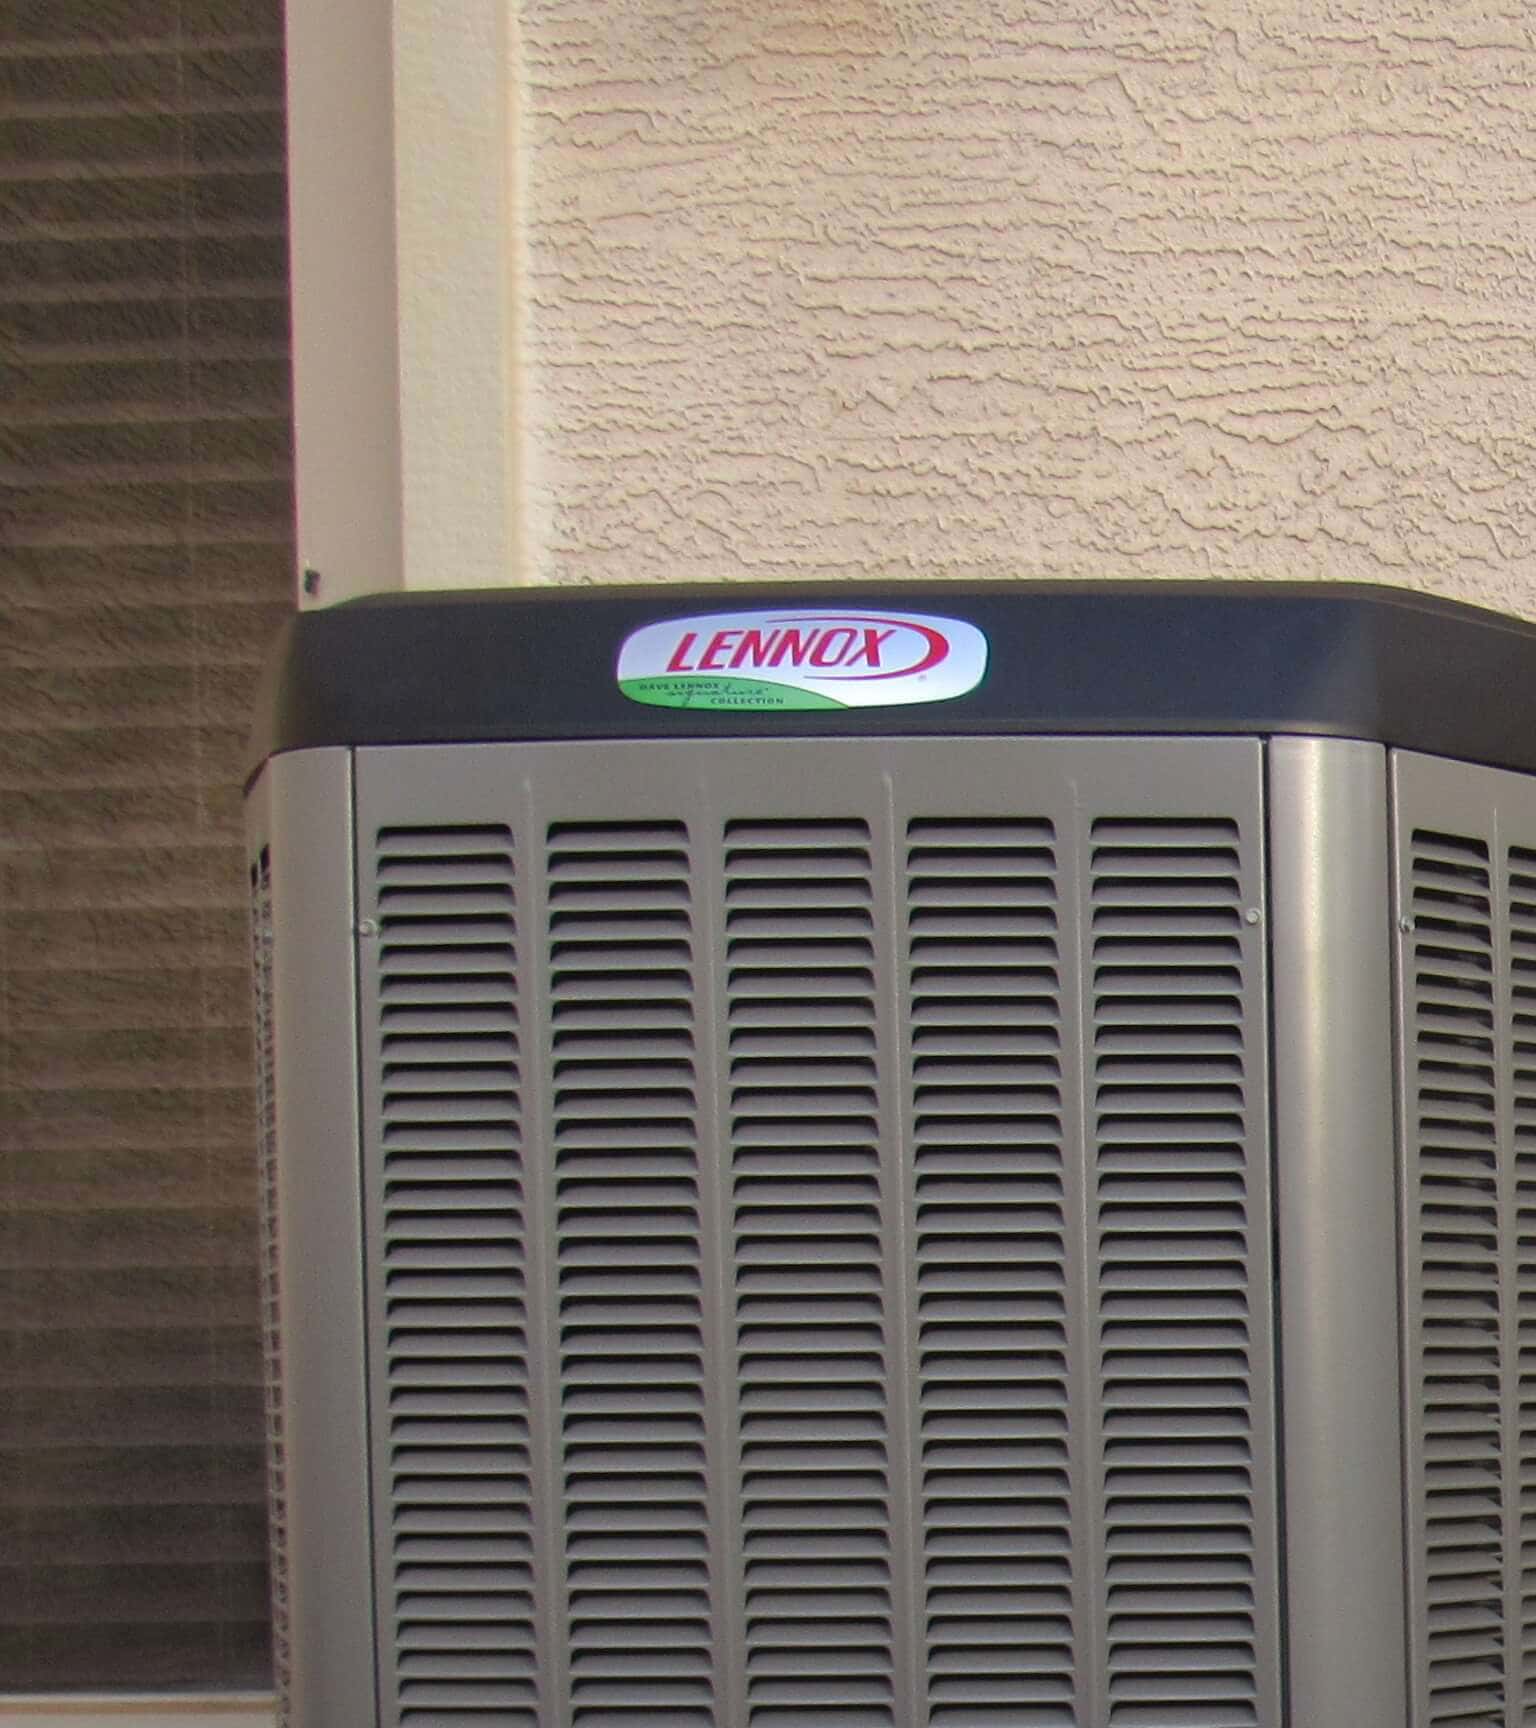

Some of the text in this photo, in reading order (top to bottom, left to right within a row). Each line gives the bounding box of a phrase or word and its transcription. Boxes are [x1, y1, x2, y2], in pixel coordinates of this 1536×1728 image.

[666, 628, 897, 672] LENNOX
[639, 682, 720, 691] DAVE LENNOX
[710, 697, 785, 705] COLLECTION
